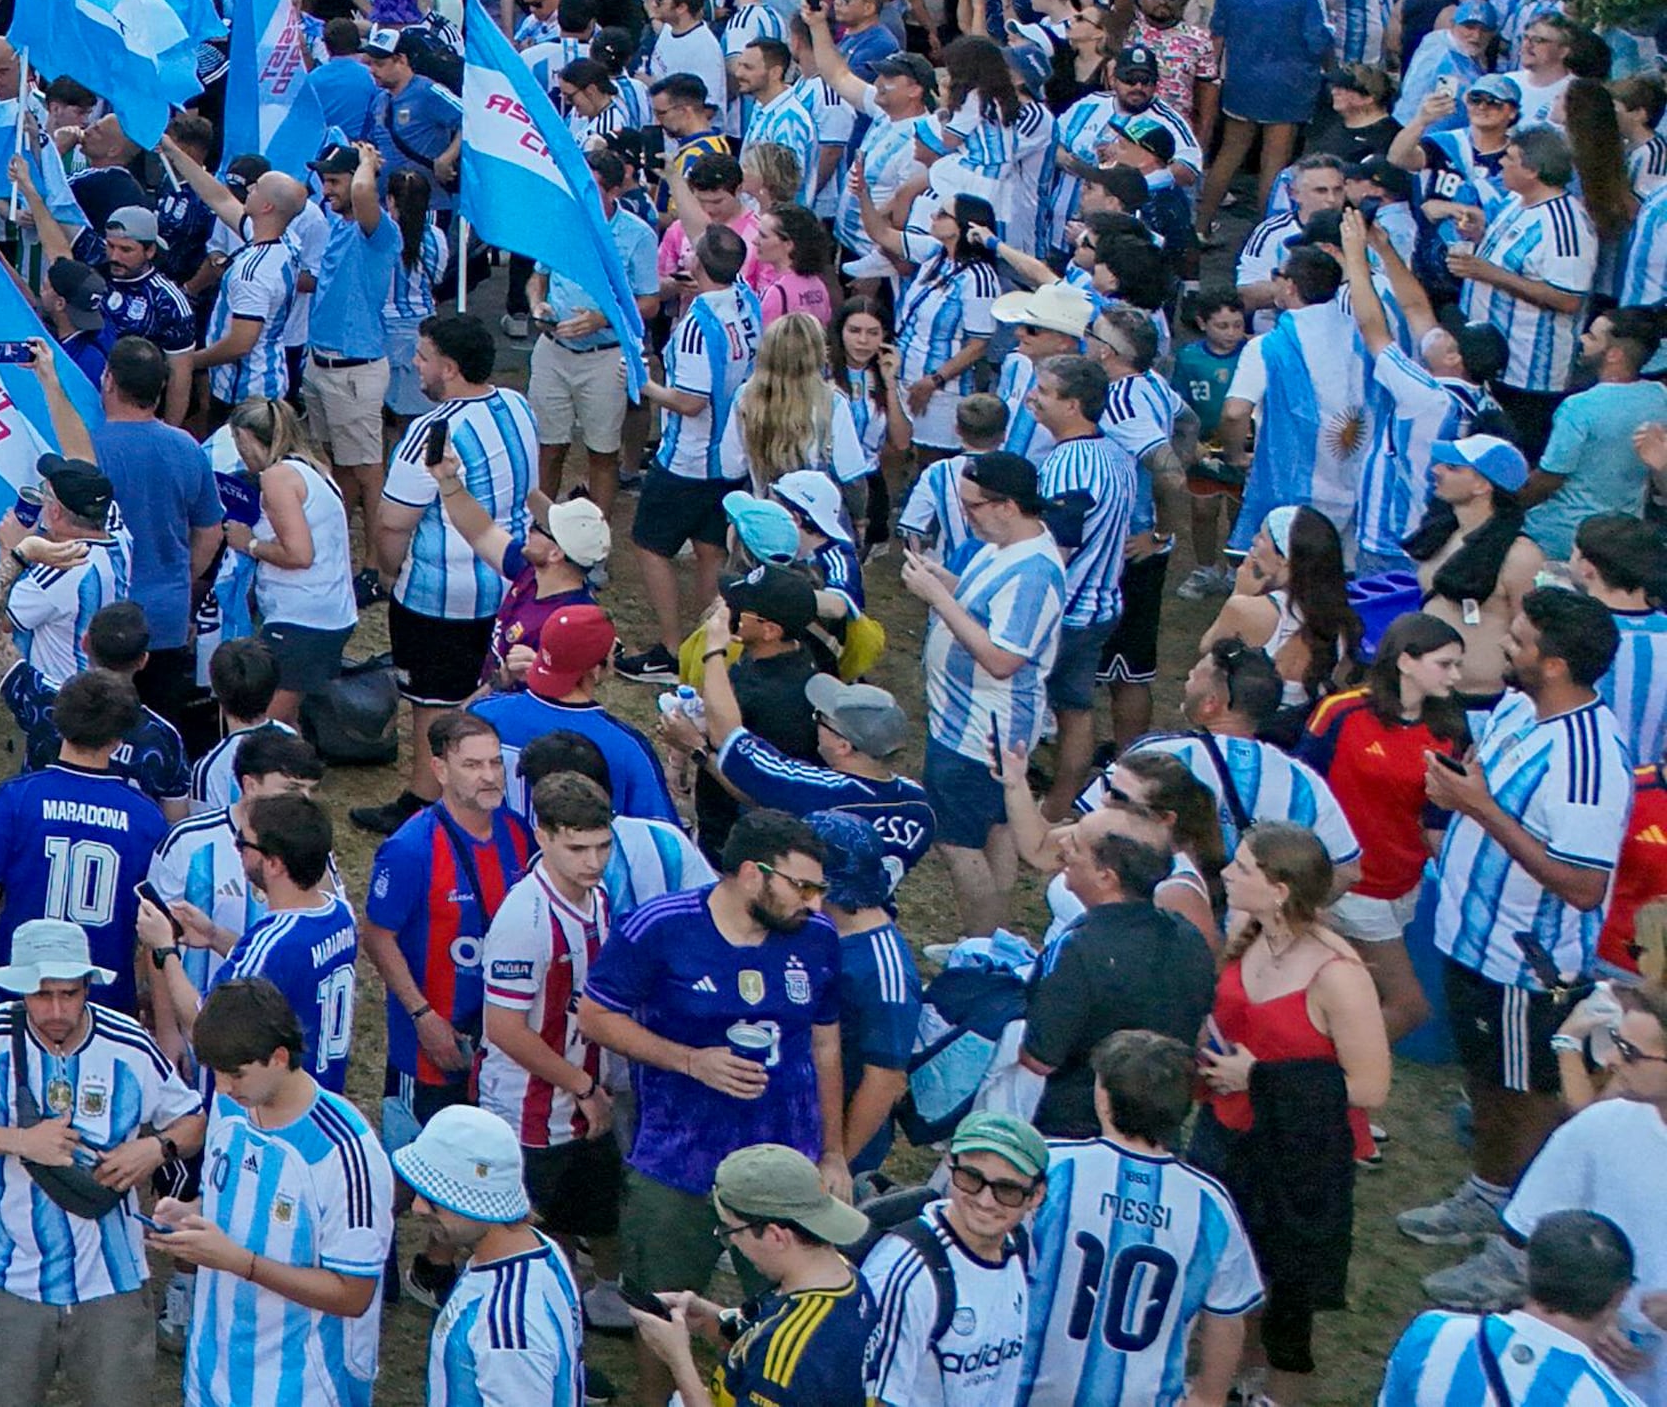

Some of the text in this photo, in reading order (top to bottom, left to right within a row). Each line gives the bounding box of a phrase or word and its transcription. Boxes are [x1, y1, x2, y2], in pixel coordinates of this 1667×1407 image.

[1434, 170, 1462, 198] 18
[1189, 380, 1211, 402] 23
[43, 799, 129, 832] MARADONA
[45, 836, 120, 927] 10
[316, 965, 357, 1073] 10
[1099, 1192, 1174, 1231] MESSI
[1067, 1230, 1178, 1352] 10
[941, 1334, 1024, 1375] adidas
